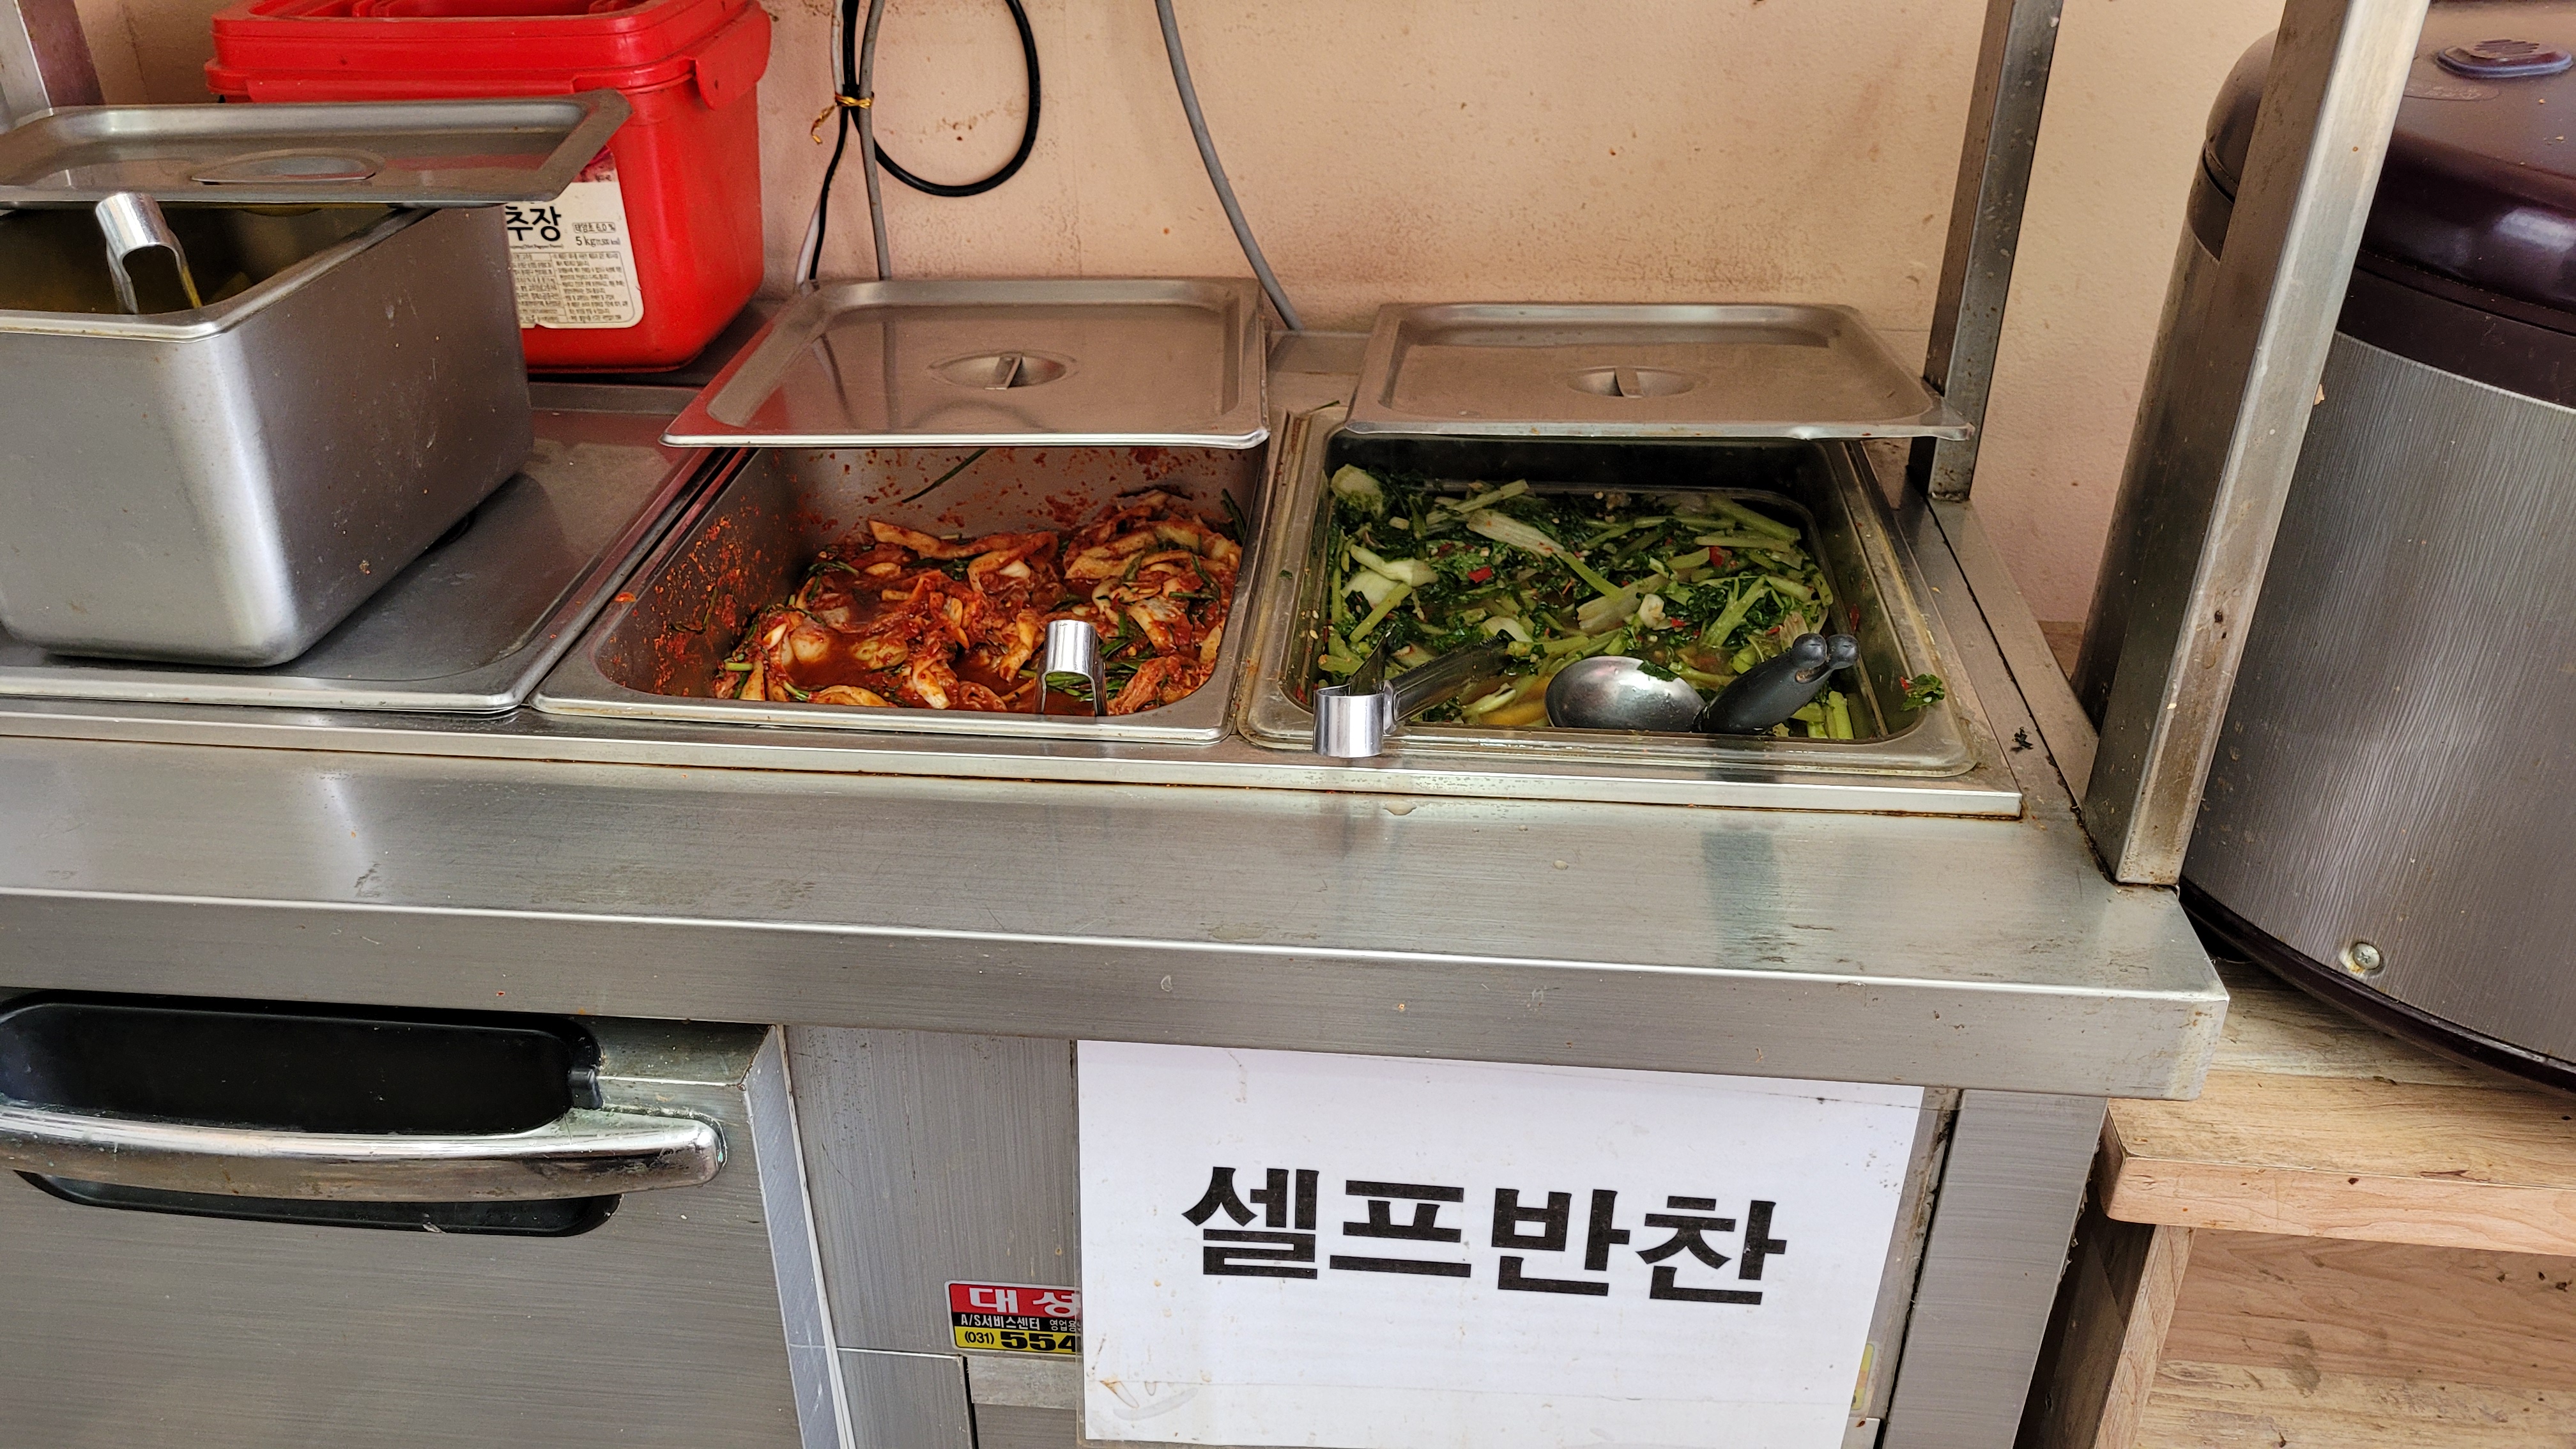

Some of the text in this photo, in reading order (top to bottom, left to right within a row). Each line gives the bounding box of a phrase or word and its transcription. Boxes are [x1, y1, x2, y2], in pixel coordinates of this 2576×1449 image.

[1182, 1165, 1787, 1305] 셀프반찬
[960, 1314, 1040, 1331] A/S서비스센터
[964, 1330, 995, 1345] (031)
